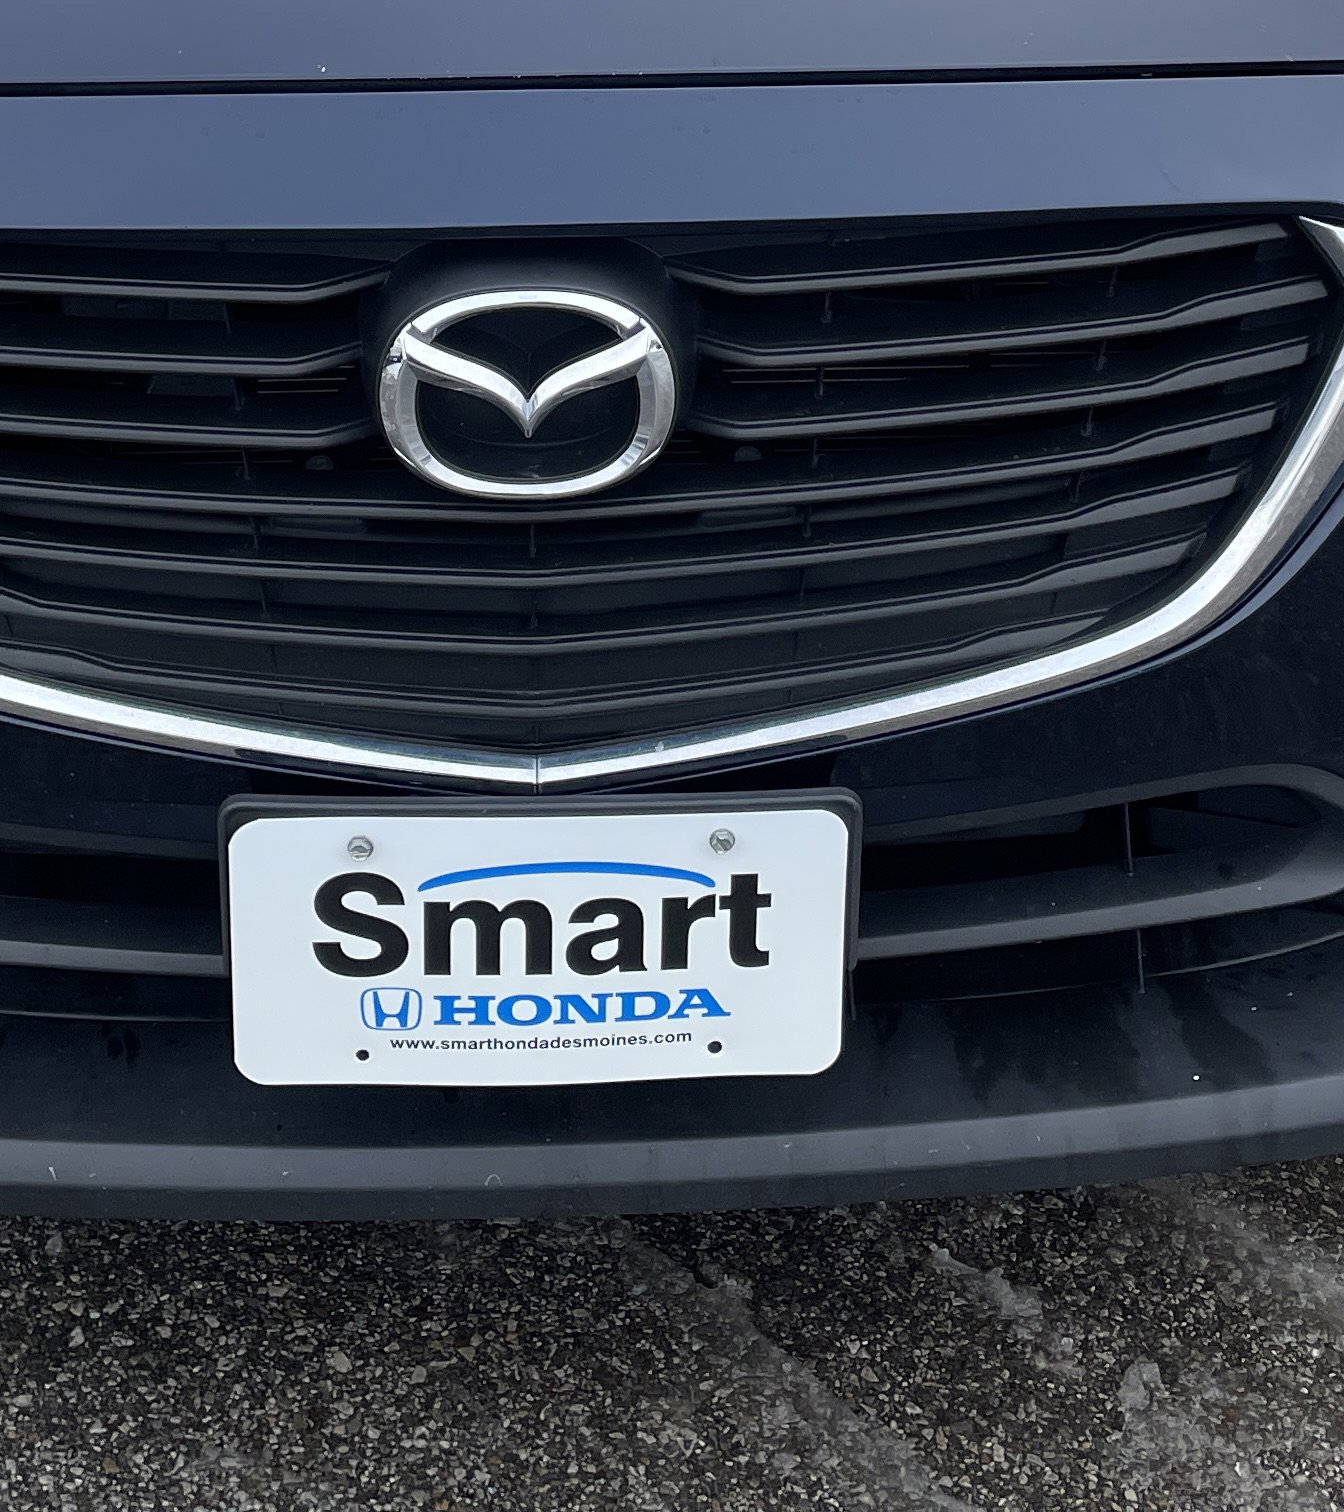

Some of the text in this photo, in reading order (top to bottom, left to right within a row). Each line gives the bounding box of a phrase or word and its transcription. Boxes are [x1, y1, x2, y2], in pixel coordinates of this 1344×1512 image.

[312, 871, 772, 977] Smart
[433, 988, 731, 1027] HONDA
[390, 1031, 693, 1052] www.smarthondadesmoines.com
